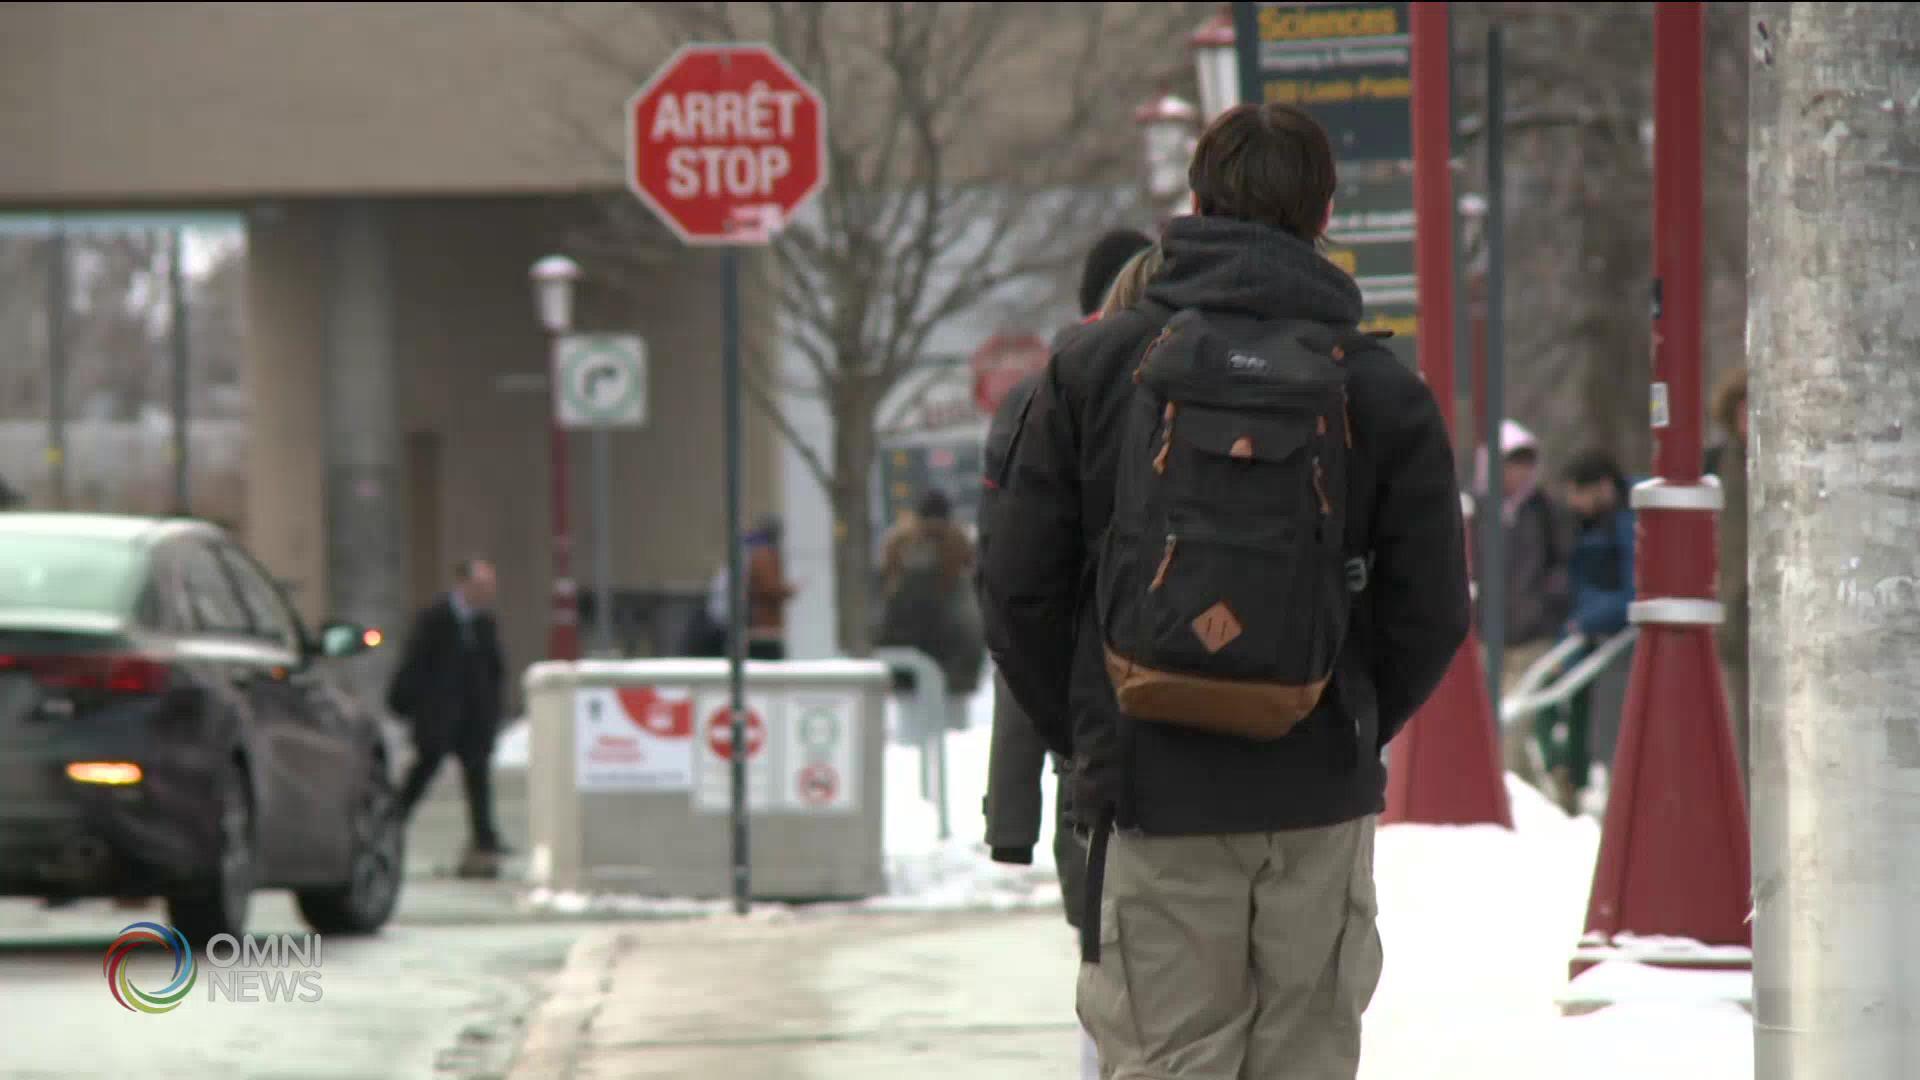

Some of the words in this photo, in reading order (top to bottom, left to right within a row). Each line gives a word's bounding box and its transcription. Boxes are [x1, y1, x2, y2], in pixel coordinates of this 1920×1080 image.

[1258, 7, 1398, 41] Sciences
[650, 80, 801, 142] ARRÊT
[666, 144, 791, 200] STOP
